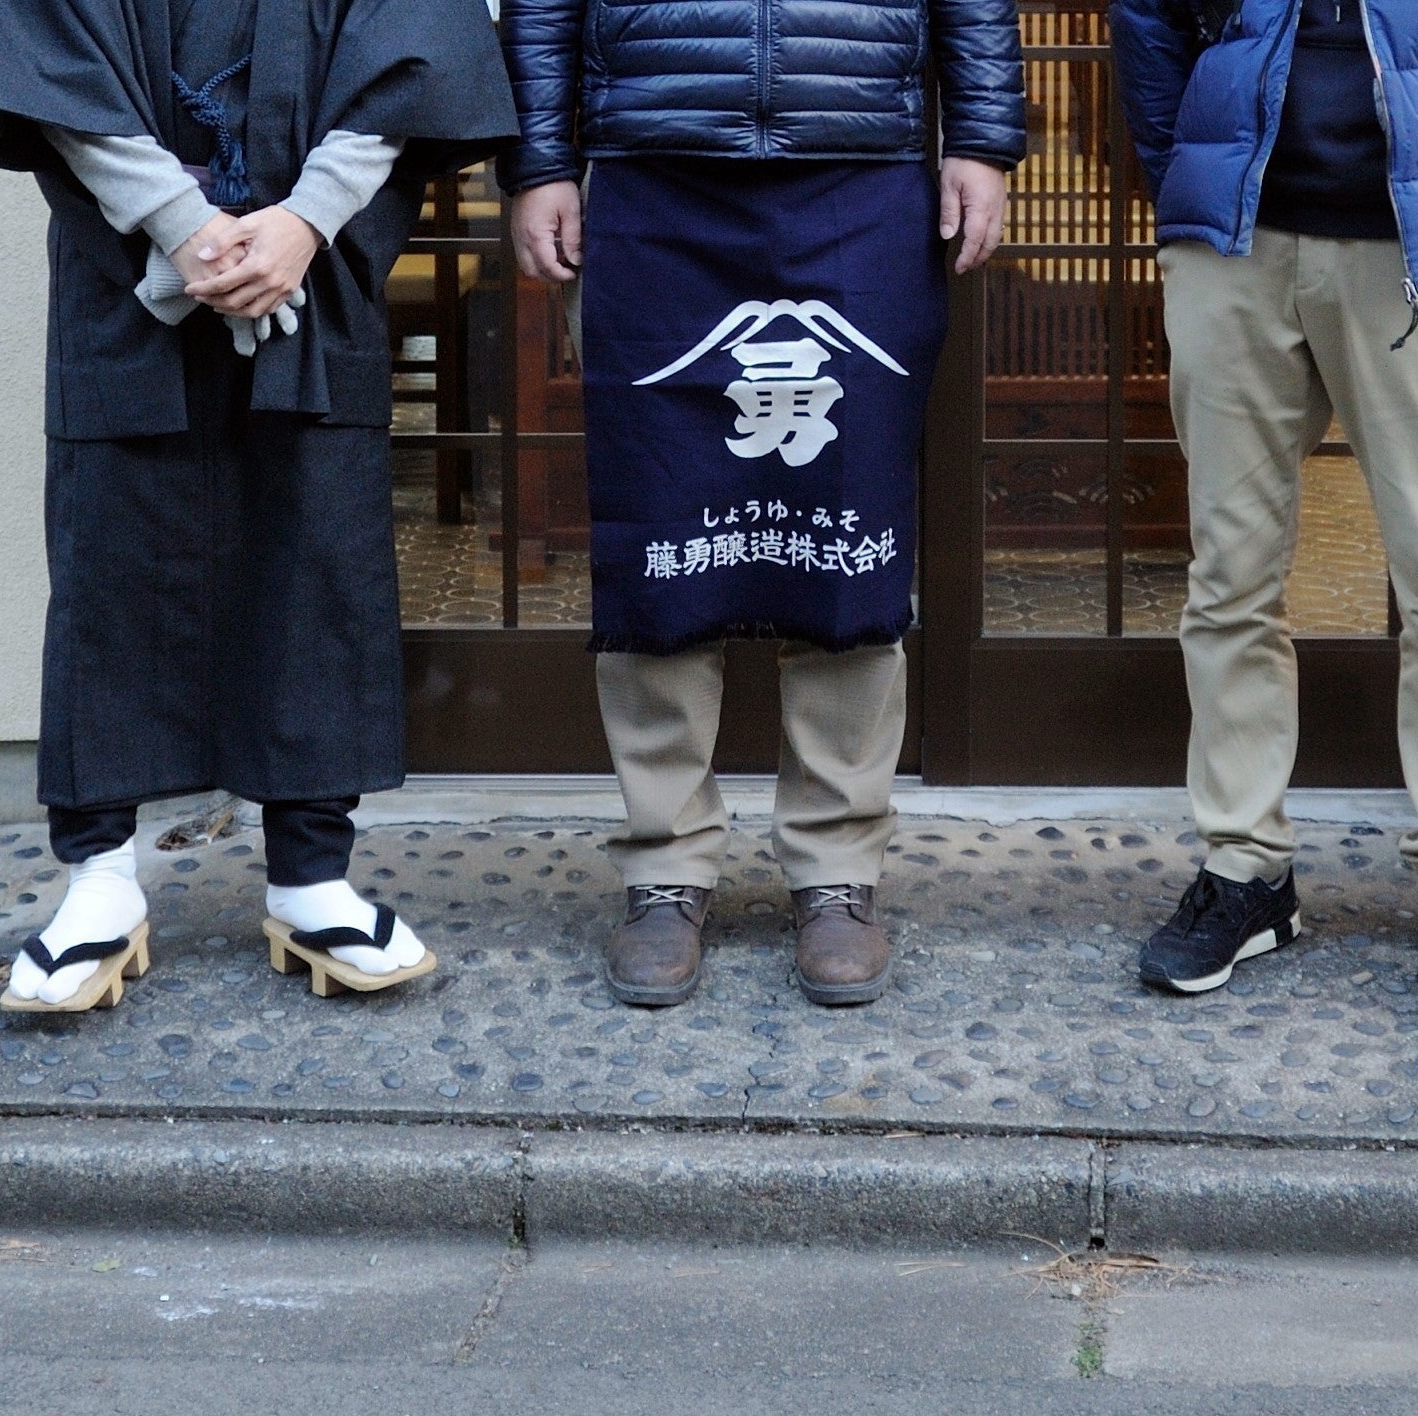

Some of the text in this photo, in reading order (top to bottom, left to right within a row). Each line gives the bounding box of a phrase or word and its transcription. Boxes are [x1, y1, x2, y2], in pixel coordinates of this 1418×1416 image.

[703, 499, 861, 533] しょうゆ・みそ
